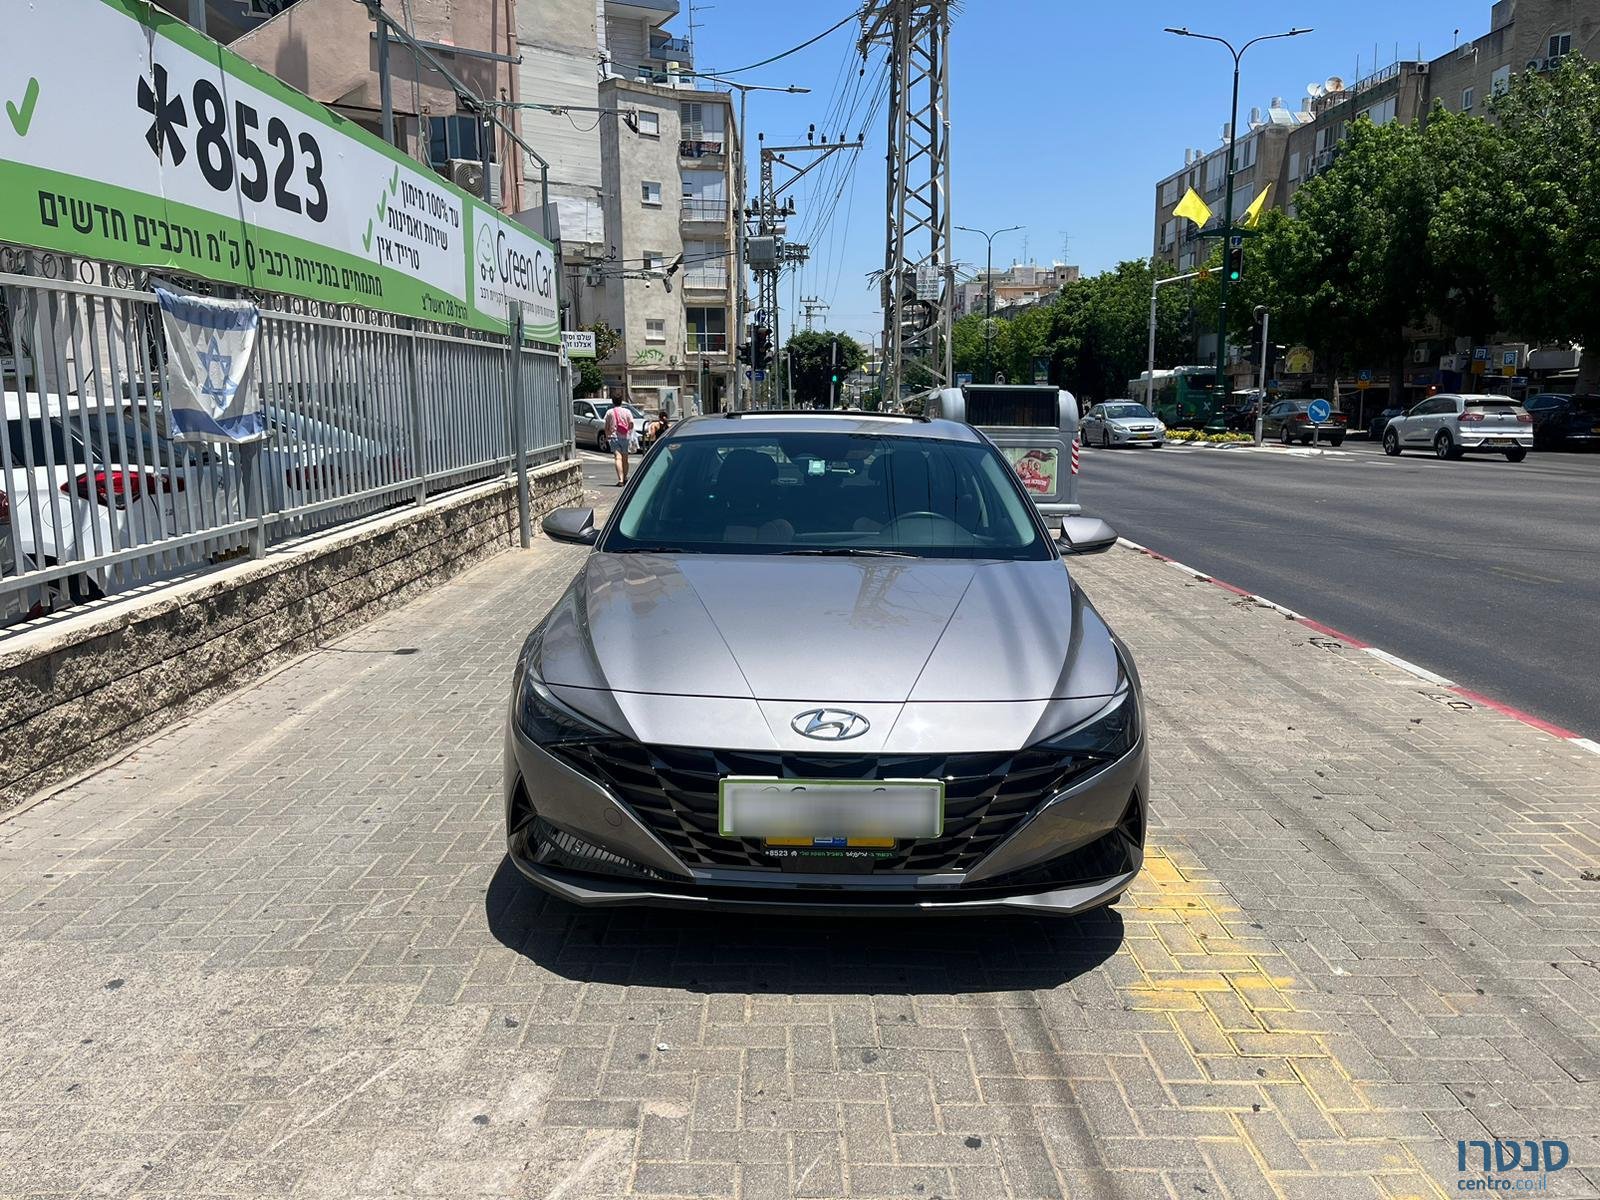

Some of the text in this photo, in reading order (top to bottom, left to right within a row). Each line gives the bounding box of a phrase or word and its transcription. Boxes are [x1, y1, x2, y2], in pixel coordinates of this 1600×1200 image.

[38, 190, 128, 242] חדשים
[401, 180, 459, 228] עד 100% מימון
[133, 214, 202, 258] ורכבים
[387, 206, 448, 250] שירות ואמינות
[245, 239, 255, 271] 0
[259, 248, 292, 278] רכבי
[294, 256, 339, 288] במכירת
[376, 235, 420, 270] טרייד אין
[496, 229, 552, 299] Green Car
[342, 267, 383, 296] מתמחים
